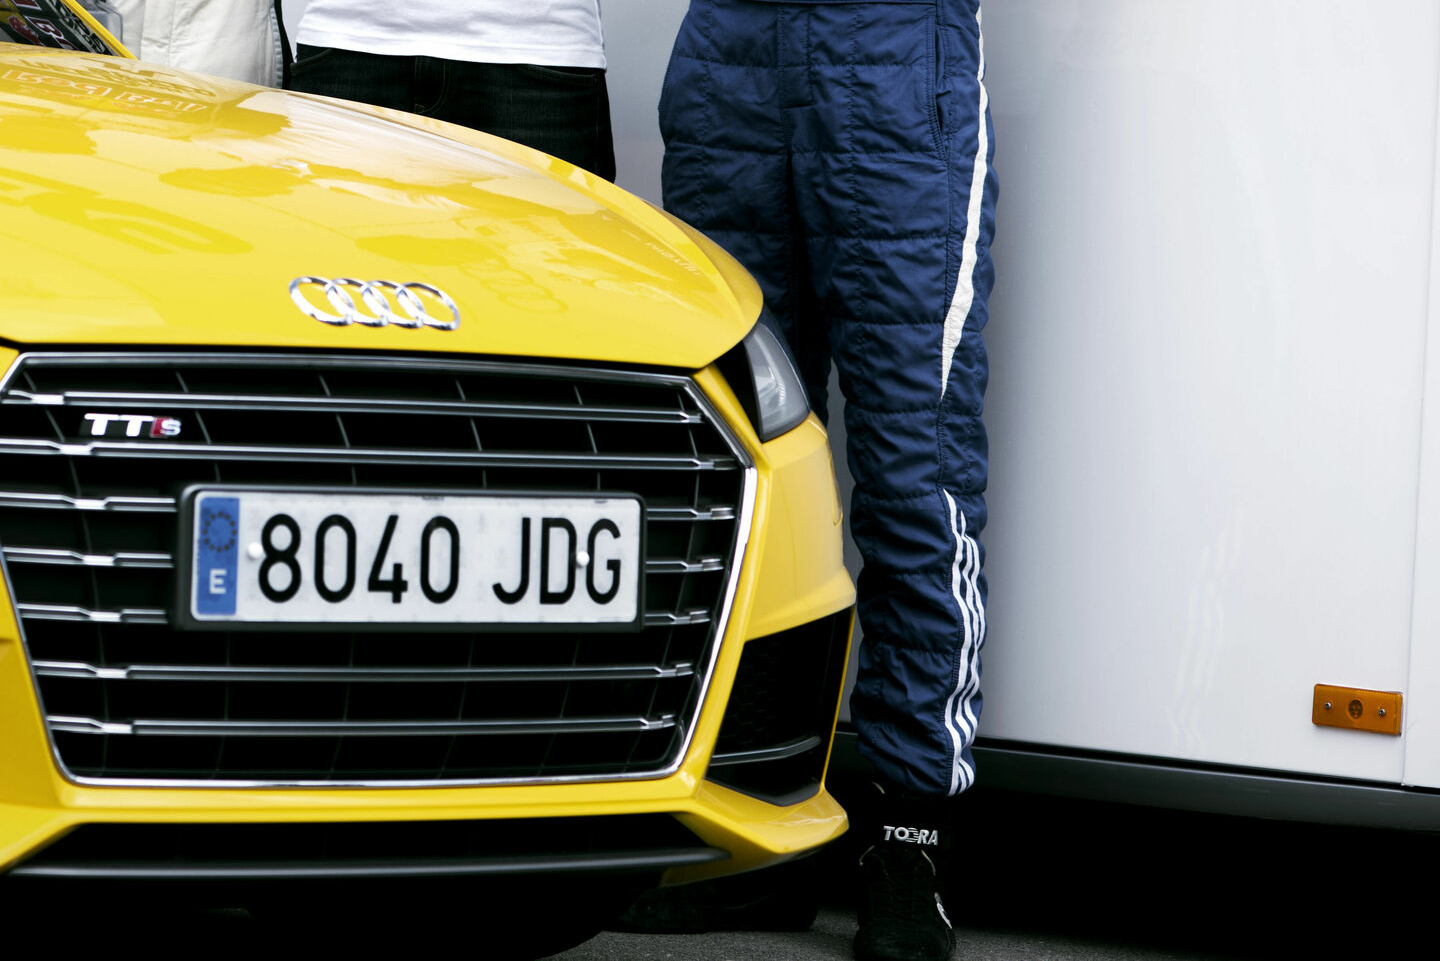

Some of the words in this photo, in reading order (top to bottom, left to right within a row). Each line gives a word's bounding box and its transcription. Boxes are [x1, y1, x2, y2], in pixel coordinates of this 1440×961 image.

[84, 413, 181, 437] TTS
[209, 569, 228, 595] E
[259, 513, 460, 604] 8040
[492, 517, 622, 606] JDG
